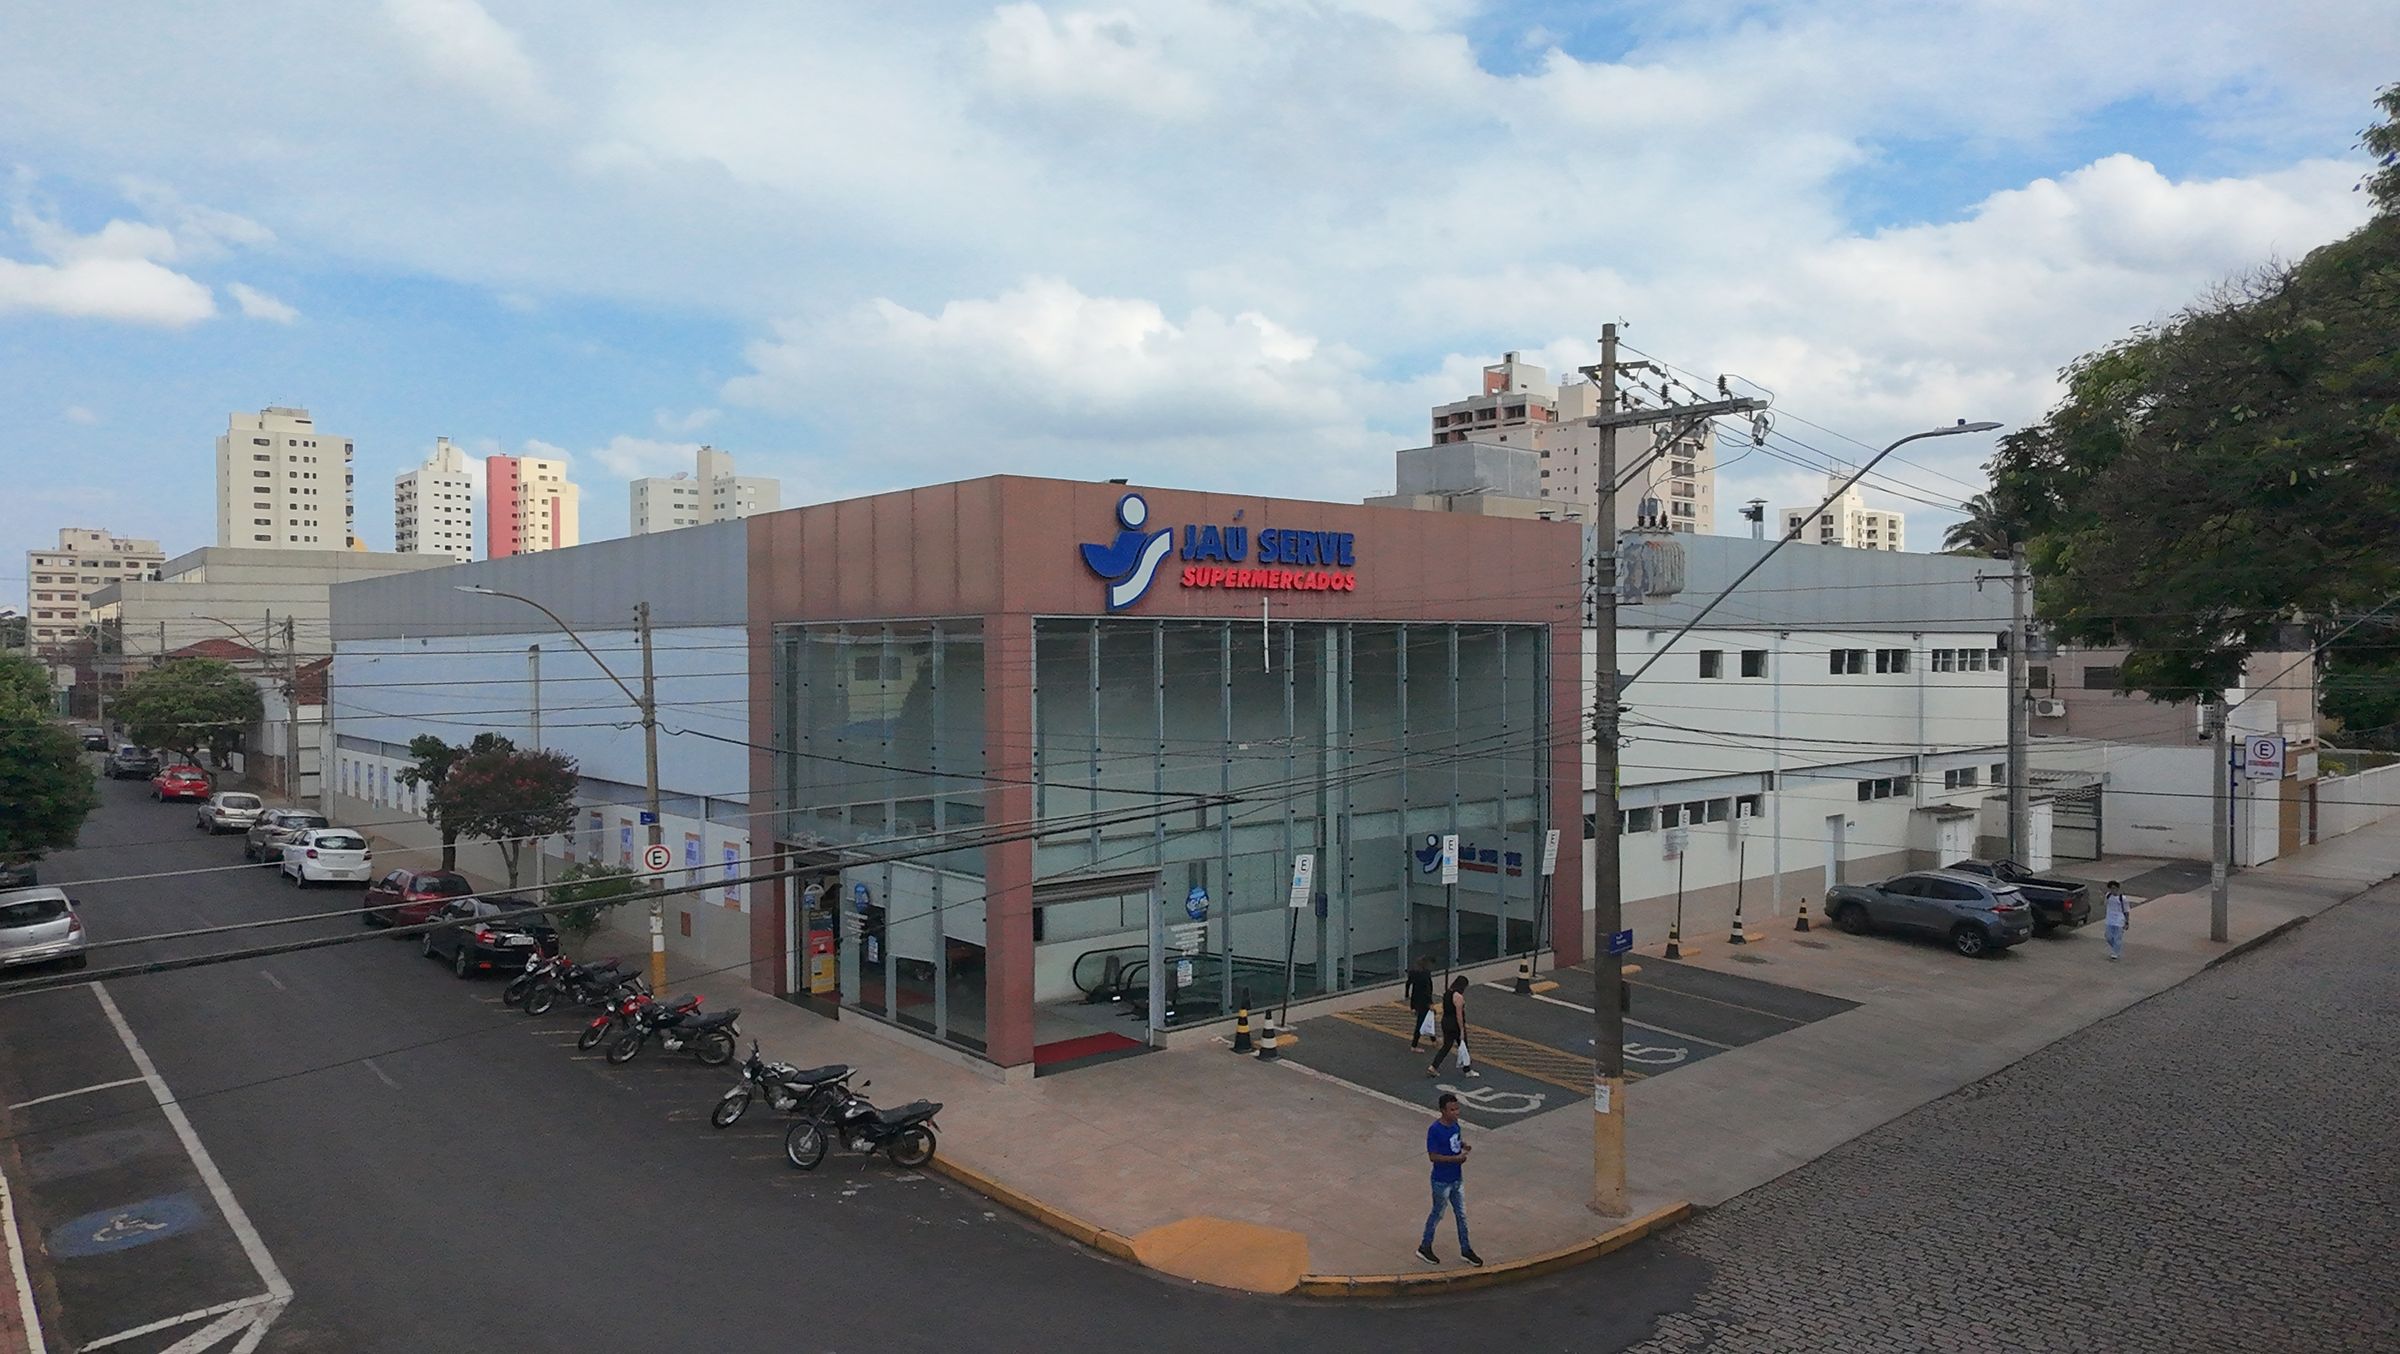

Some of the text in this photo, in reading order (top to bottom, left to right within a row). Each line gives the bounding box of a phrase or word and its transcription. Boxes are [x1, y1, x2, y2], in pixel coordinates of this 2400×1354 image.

[1181, 509, 1356, 567] JAÚ SERVE
[1182, 566, 1357, 592] SUPERMERCADOS
[2260, 743, 2269, 756] E
[1449, 839, 1454, 850] E
[652, 850, 662, 865] E
[1301, 859, 1307, 871] E
